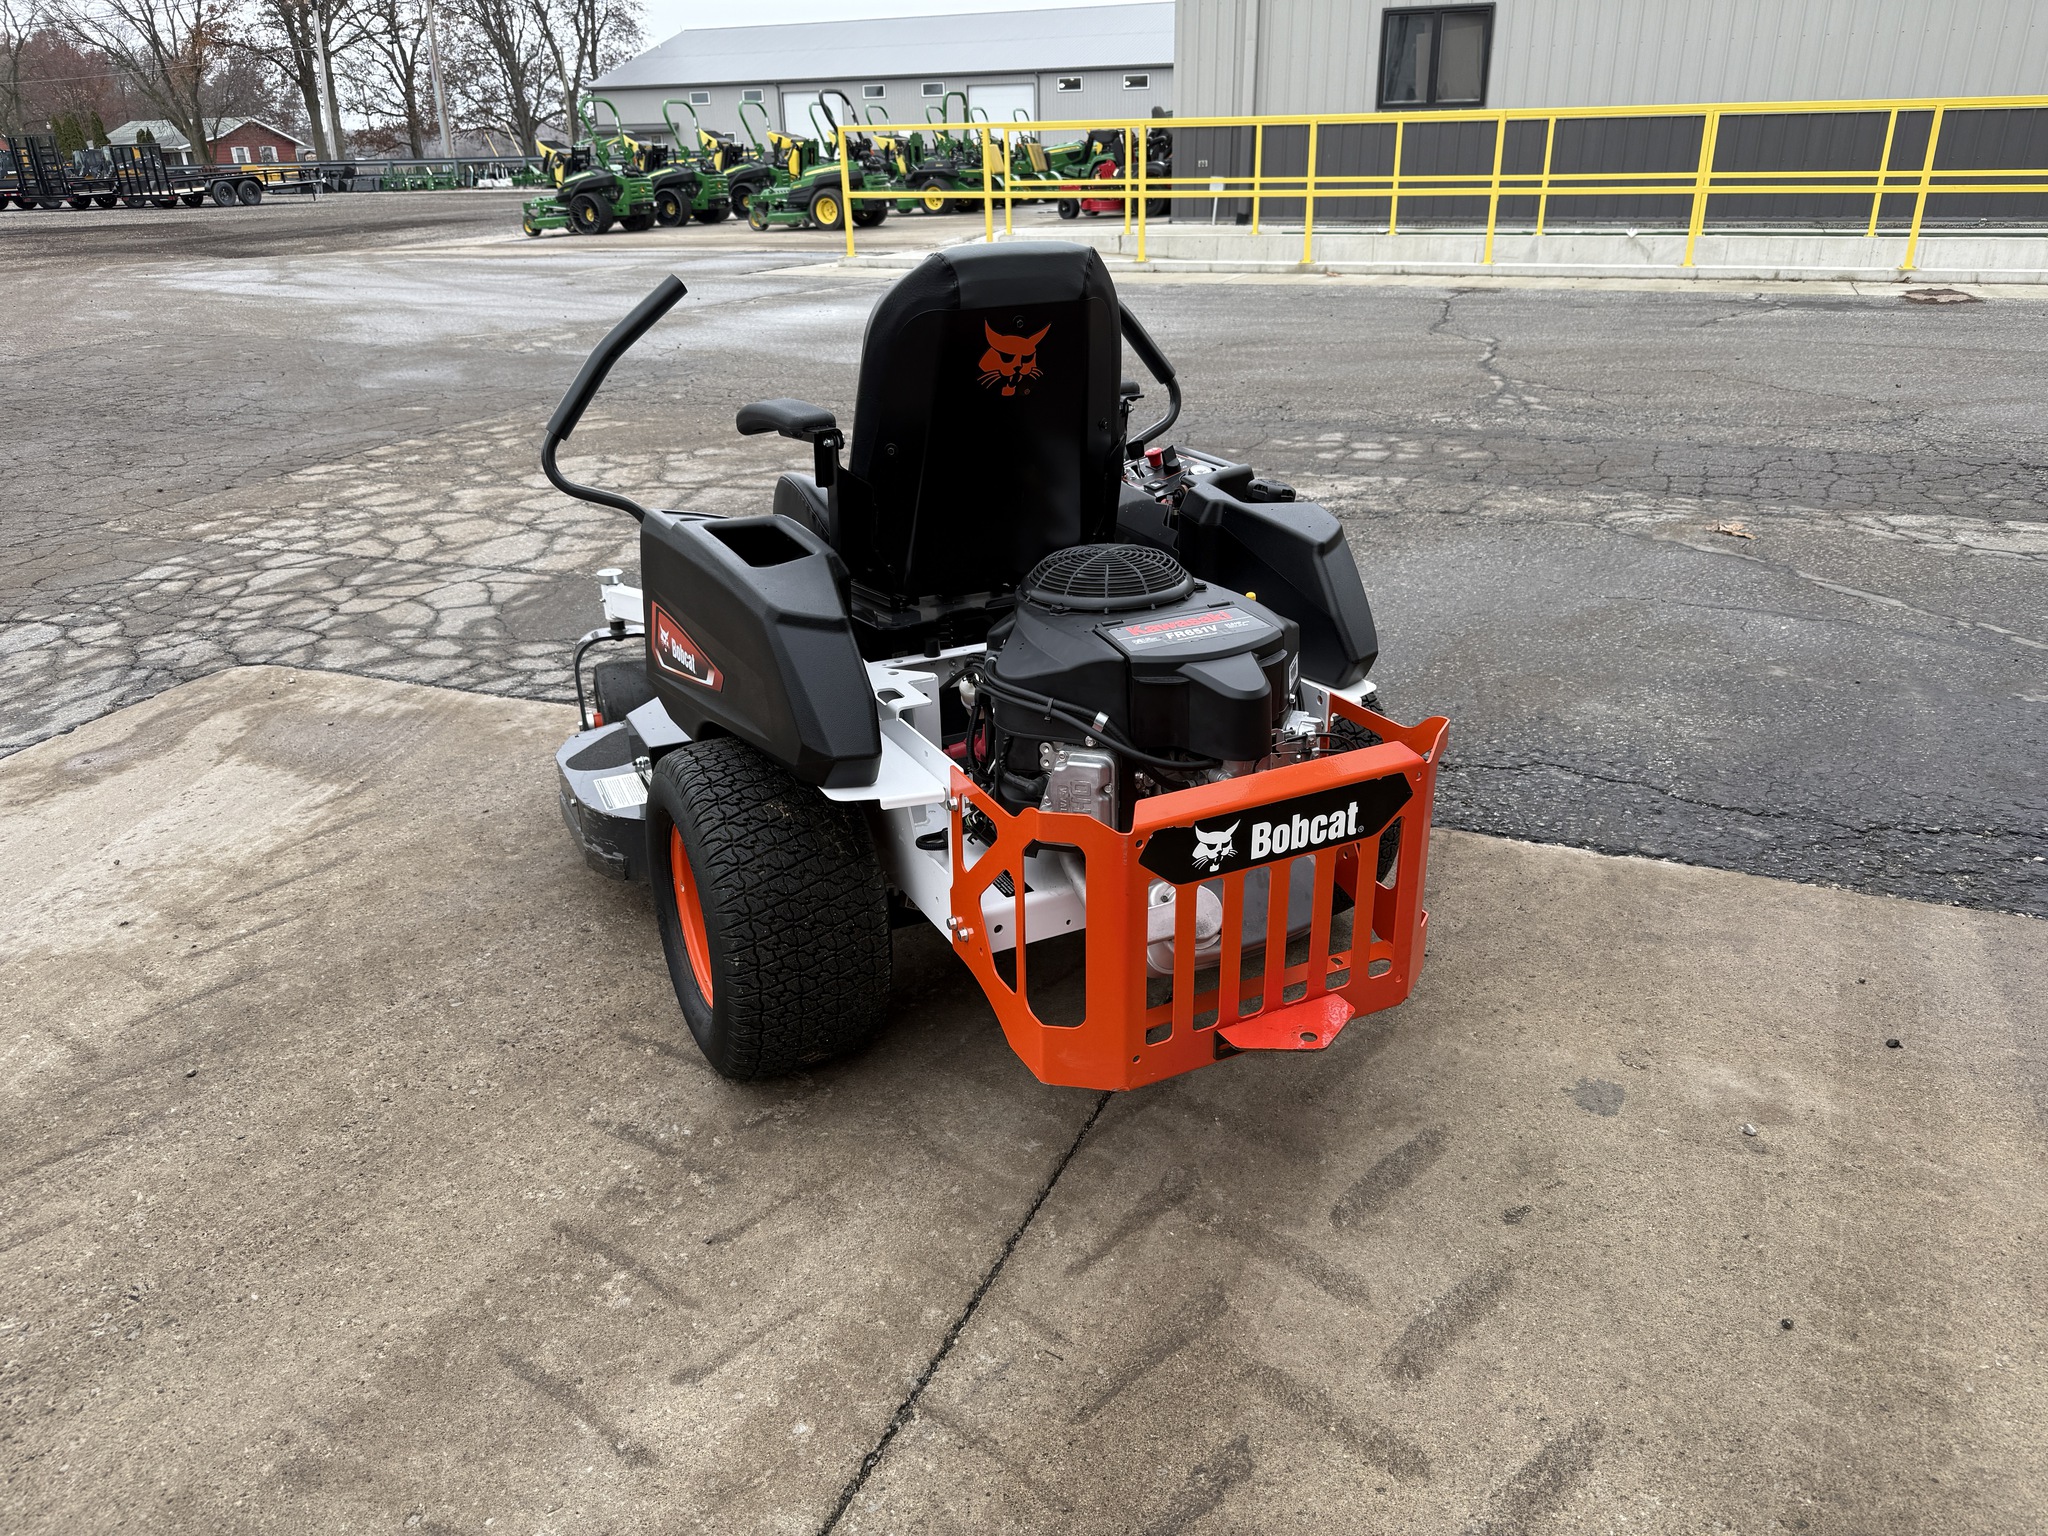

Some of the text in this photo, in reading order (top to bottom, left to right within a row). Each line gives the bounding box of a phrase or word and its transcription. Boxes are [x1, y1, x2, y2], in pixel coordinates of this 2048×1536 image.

[1125, 610, 1232, 636] Kawasaki
[1165, 624, 1217, 640] FR651V
[671, 637, 696, 675] Bobcat
[1250, 801, 1359, 860] Bobcat
